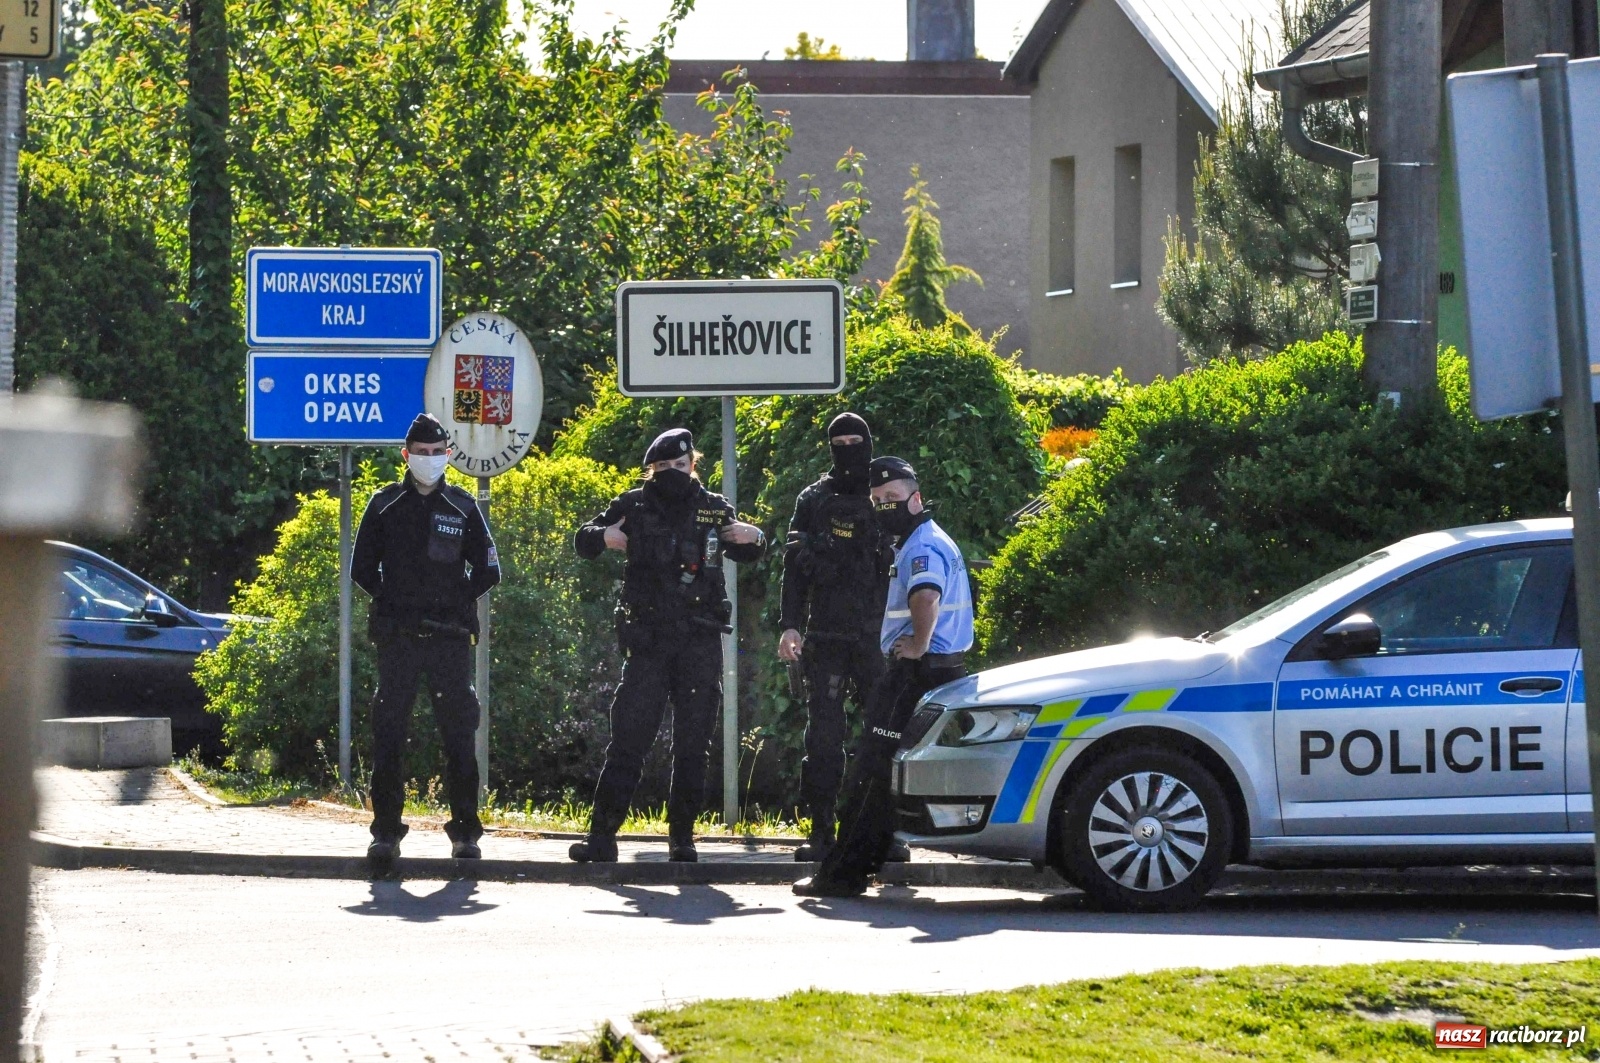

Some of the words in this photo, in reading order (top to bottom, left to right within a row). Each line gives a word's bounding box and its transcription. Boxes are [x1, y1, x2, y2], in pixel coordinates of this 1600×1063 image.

[24, 0, 39, 17] 12
[30, 26, 39, 44] 5
[262, 268, 424, 294] MORAVSKOSLEZSKÝ
[322, 304, 365, 326] KRAJ
[448, 317, 520, 346] ČESKÁ
[652, 314, 812, 357] ŠILHEŘOVICE
[304, 373, 381, 395] OKRES
[304, 401, 384, 423] OPAVA
[434, 514, 463, 524] POLICIE
[438, 524, 463, 536] 335371
[1301, 683, 1384, 700] POMÁHAT
[1390, 685, 1402, 698] A
[1407, 681, 1484, 697] CHRÁNIT
[872, 726, 902, 740] POLICIE
[1300, 725, 1545, 776] POLICIE
